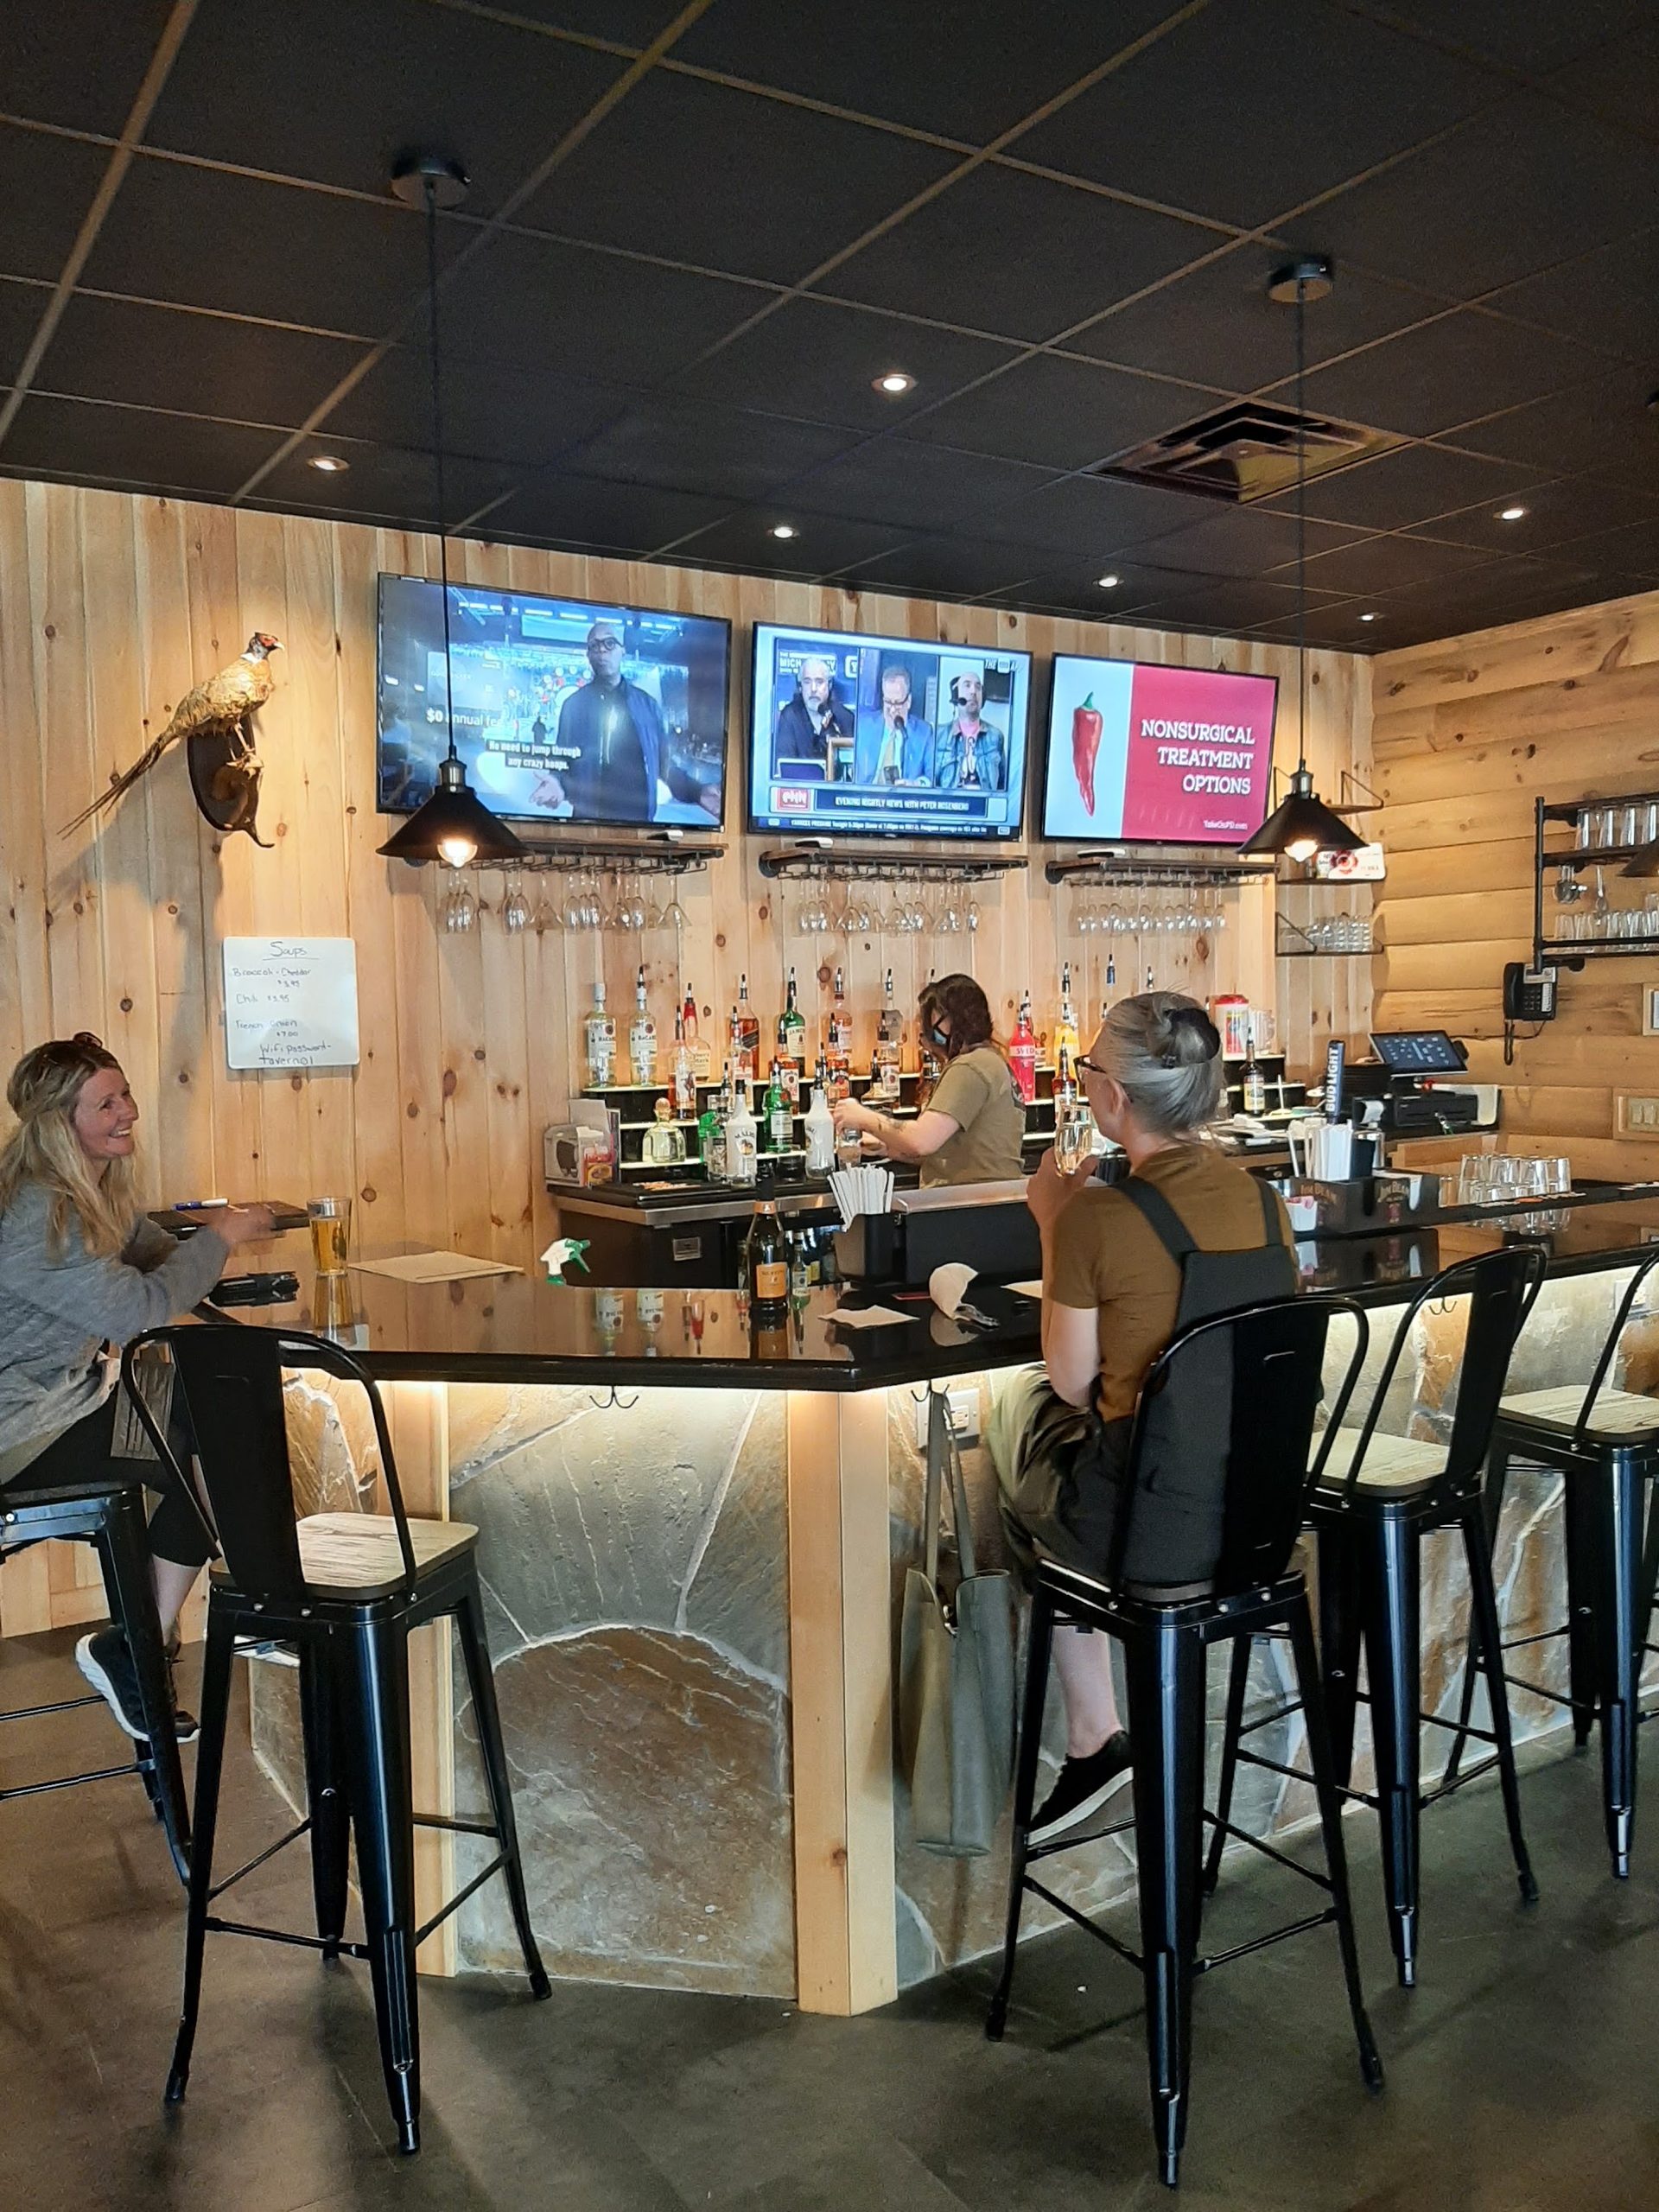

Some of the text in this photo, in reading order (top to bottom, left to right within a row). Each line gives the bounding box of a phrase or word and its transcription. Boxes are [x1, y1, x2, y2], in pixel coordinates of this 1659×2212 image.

[427, 707, 443, 723] $0
[1141, 719, 1255, 745] NONSURGICAL
[501, 741, 521, 753] need
[522, 743, 531, 753] to
[532, 743, 550, 756] jump
[552, 744, 582, 758] through
[1157, 747, 1255, 770] TREATMENT
[508, 758, 522, 768] any
[523, 759, 543, 769] crazy
[1182, 773, 1252, 795] OPTIONS
[270, 941, 308, 957] Soups
[1325, 1046, 1339, 1112] BUD LIGHT
